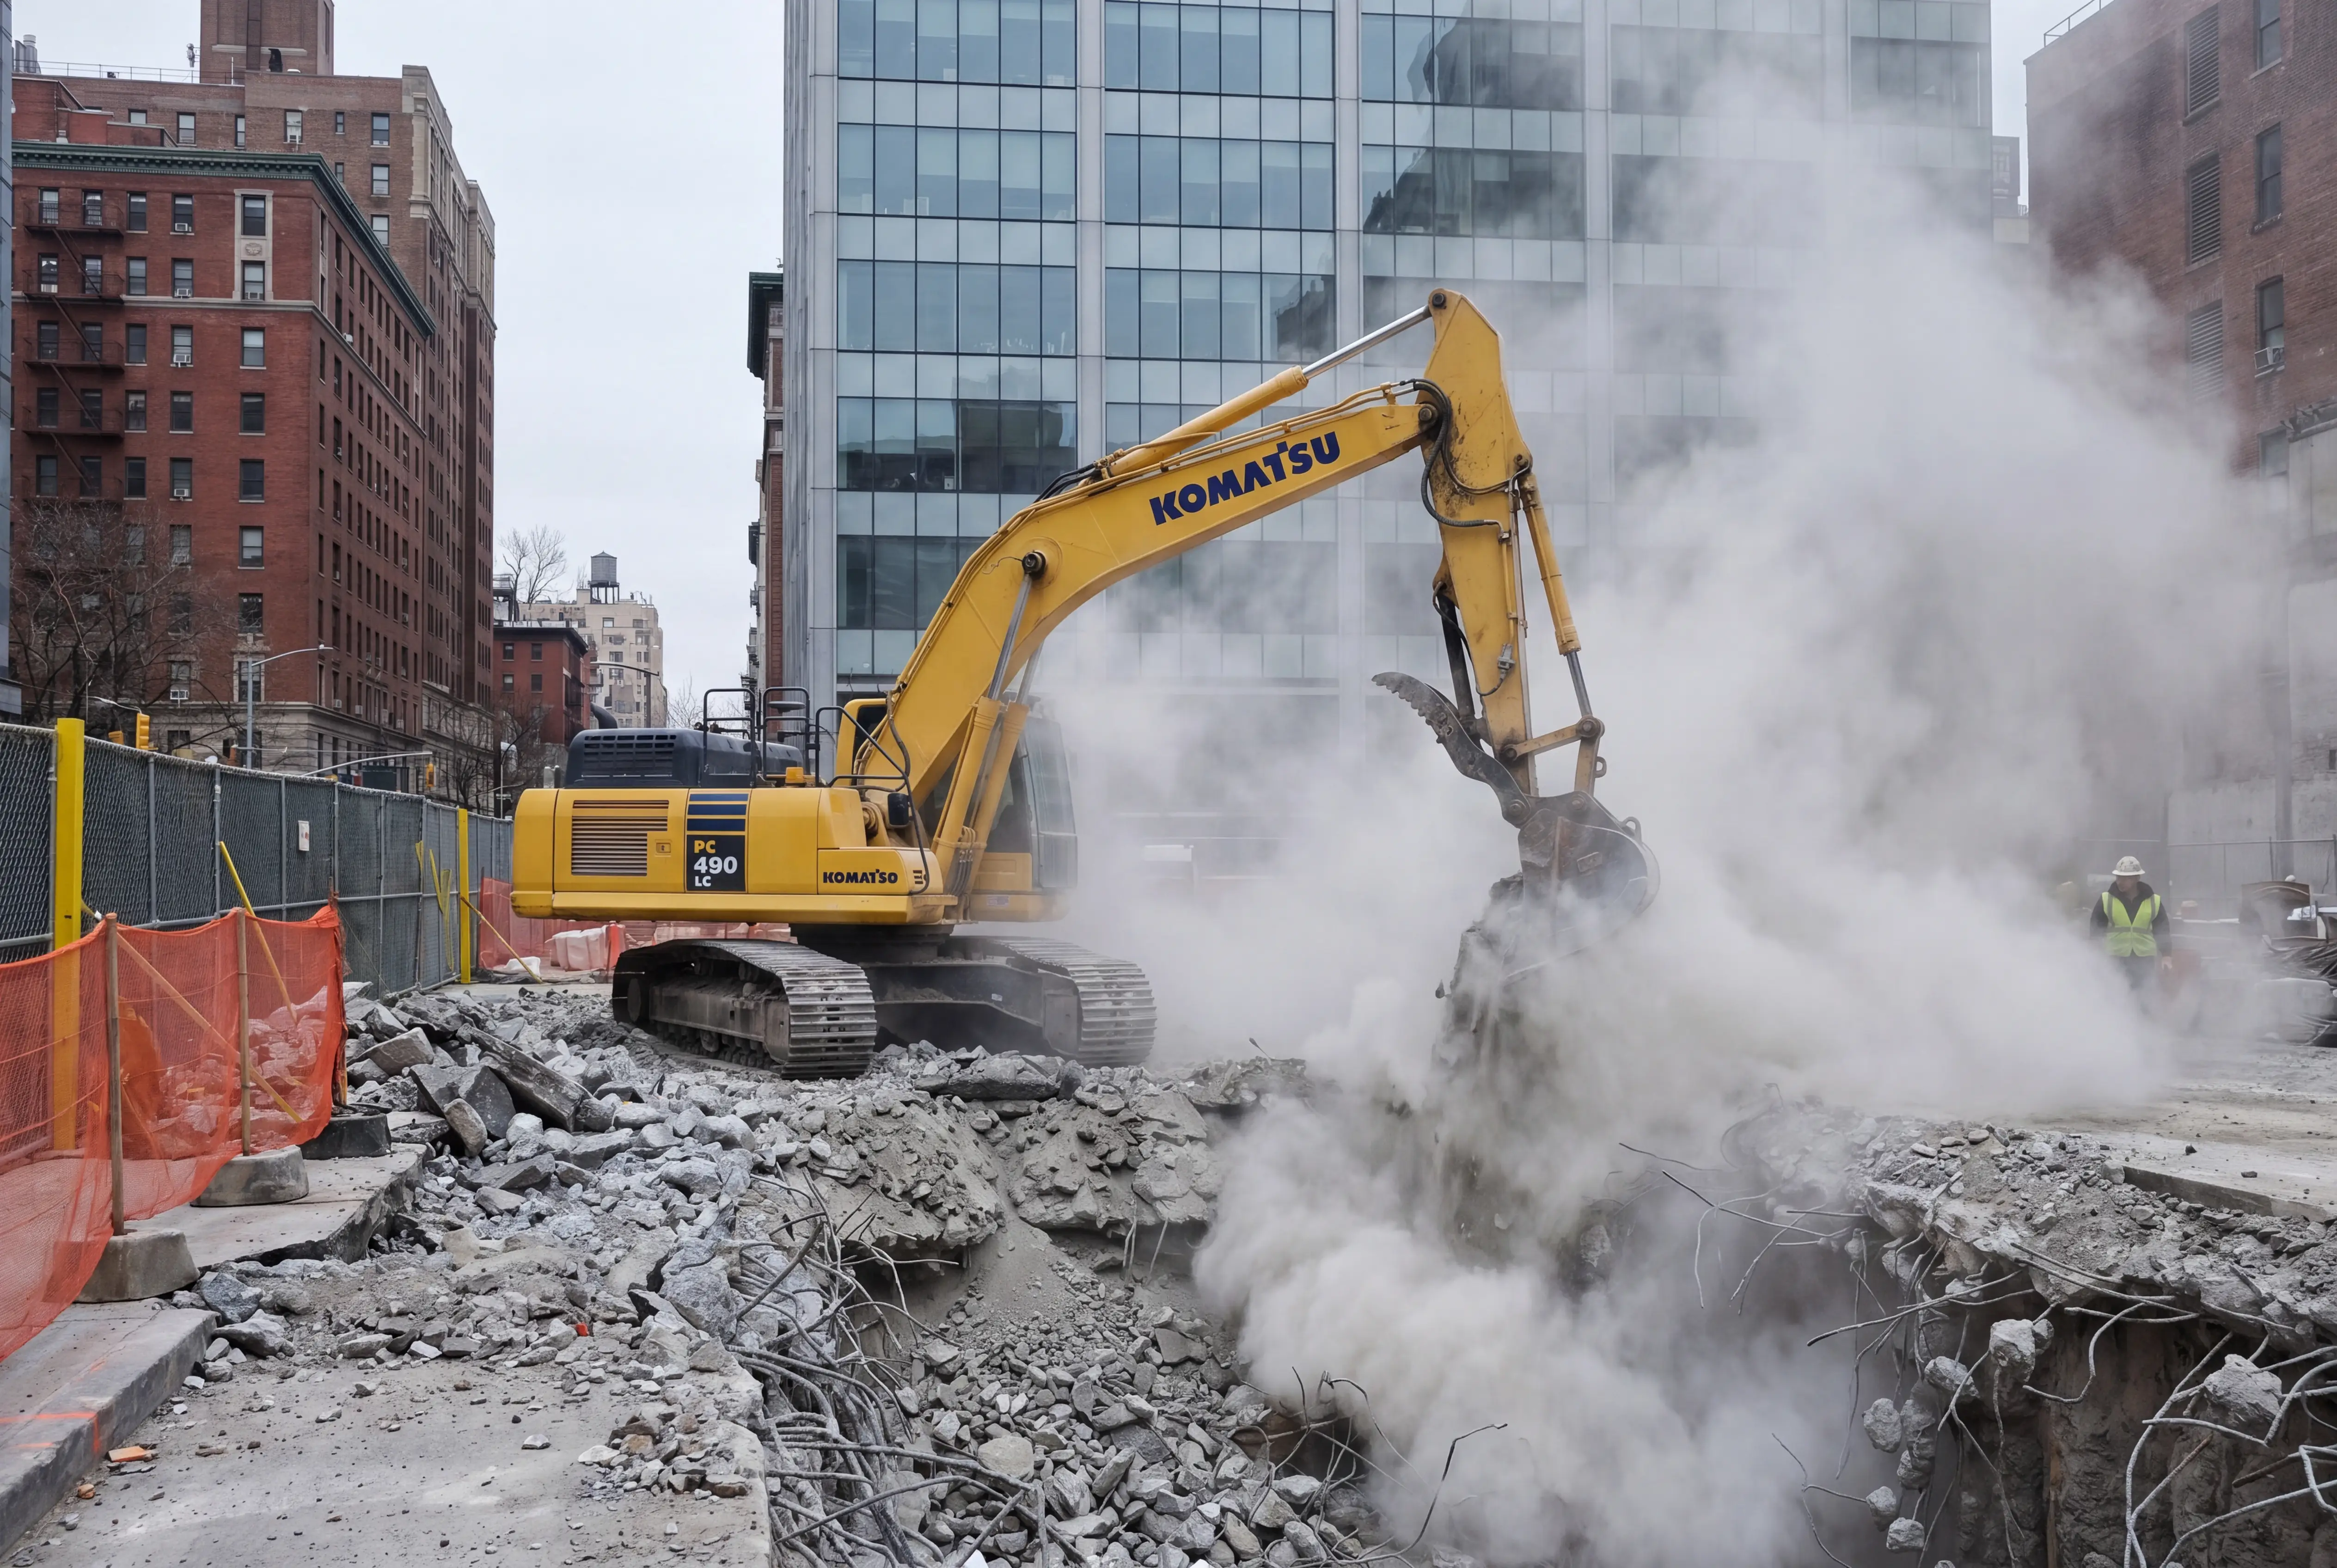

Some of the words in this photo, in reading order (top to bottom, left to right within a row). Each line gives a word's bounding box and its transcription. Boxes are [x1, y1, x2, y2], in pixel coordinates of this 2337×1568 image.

[1150, 432, 1340, 525] KOMATSU
[694, 840, 716, 853] PC
[694, 857, 738, 874] 490
[695, 876, 711, 887] LC
